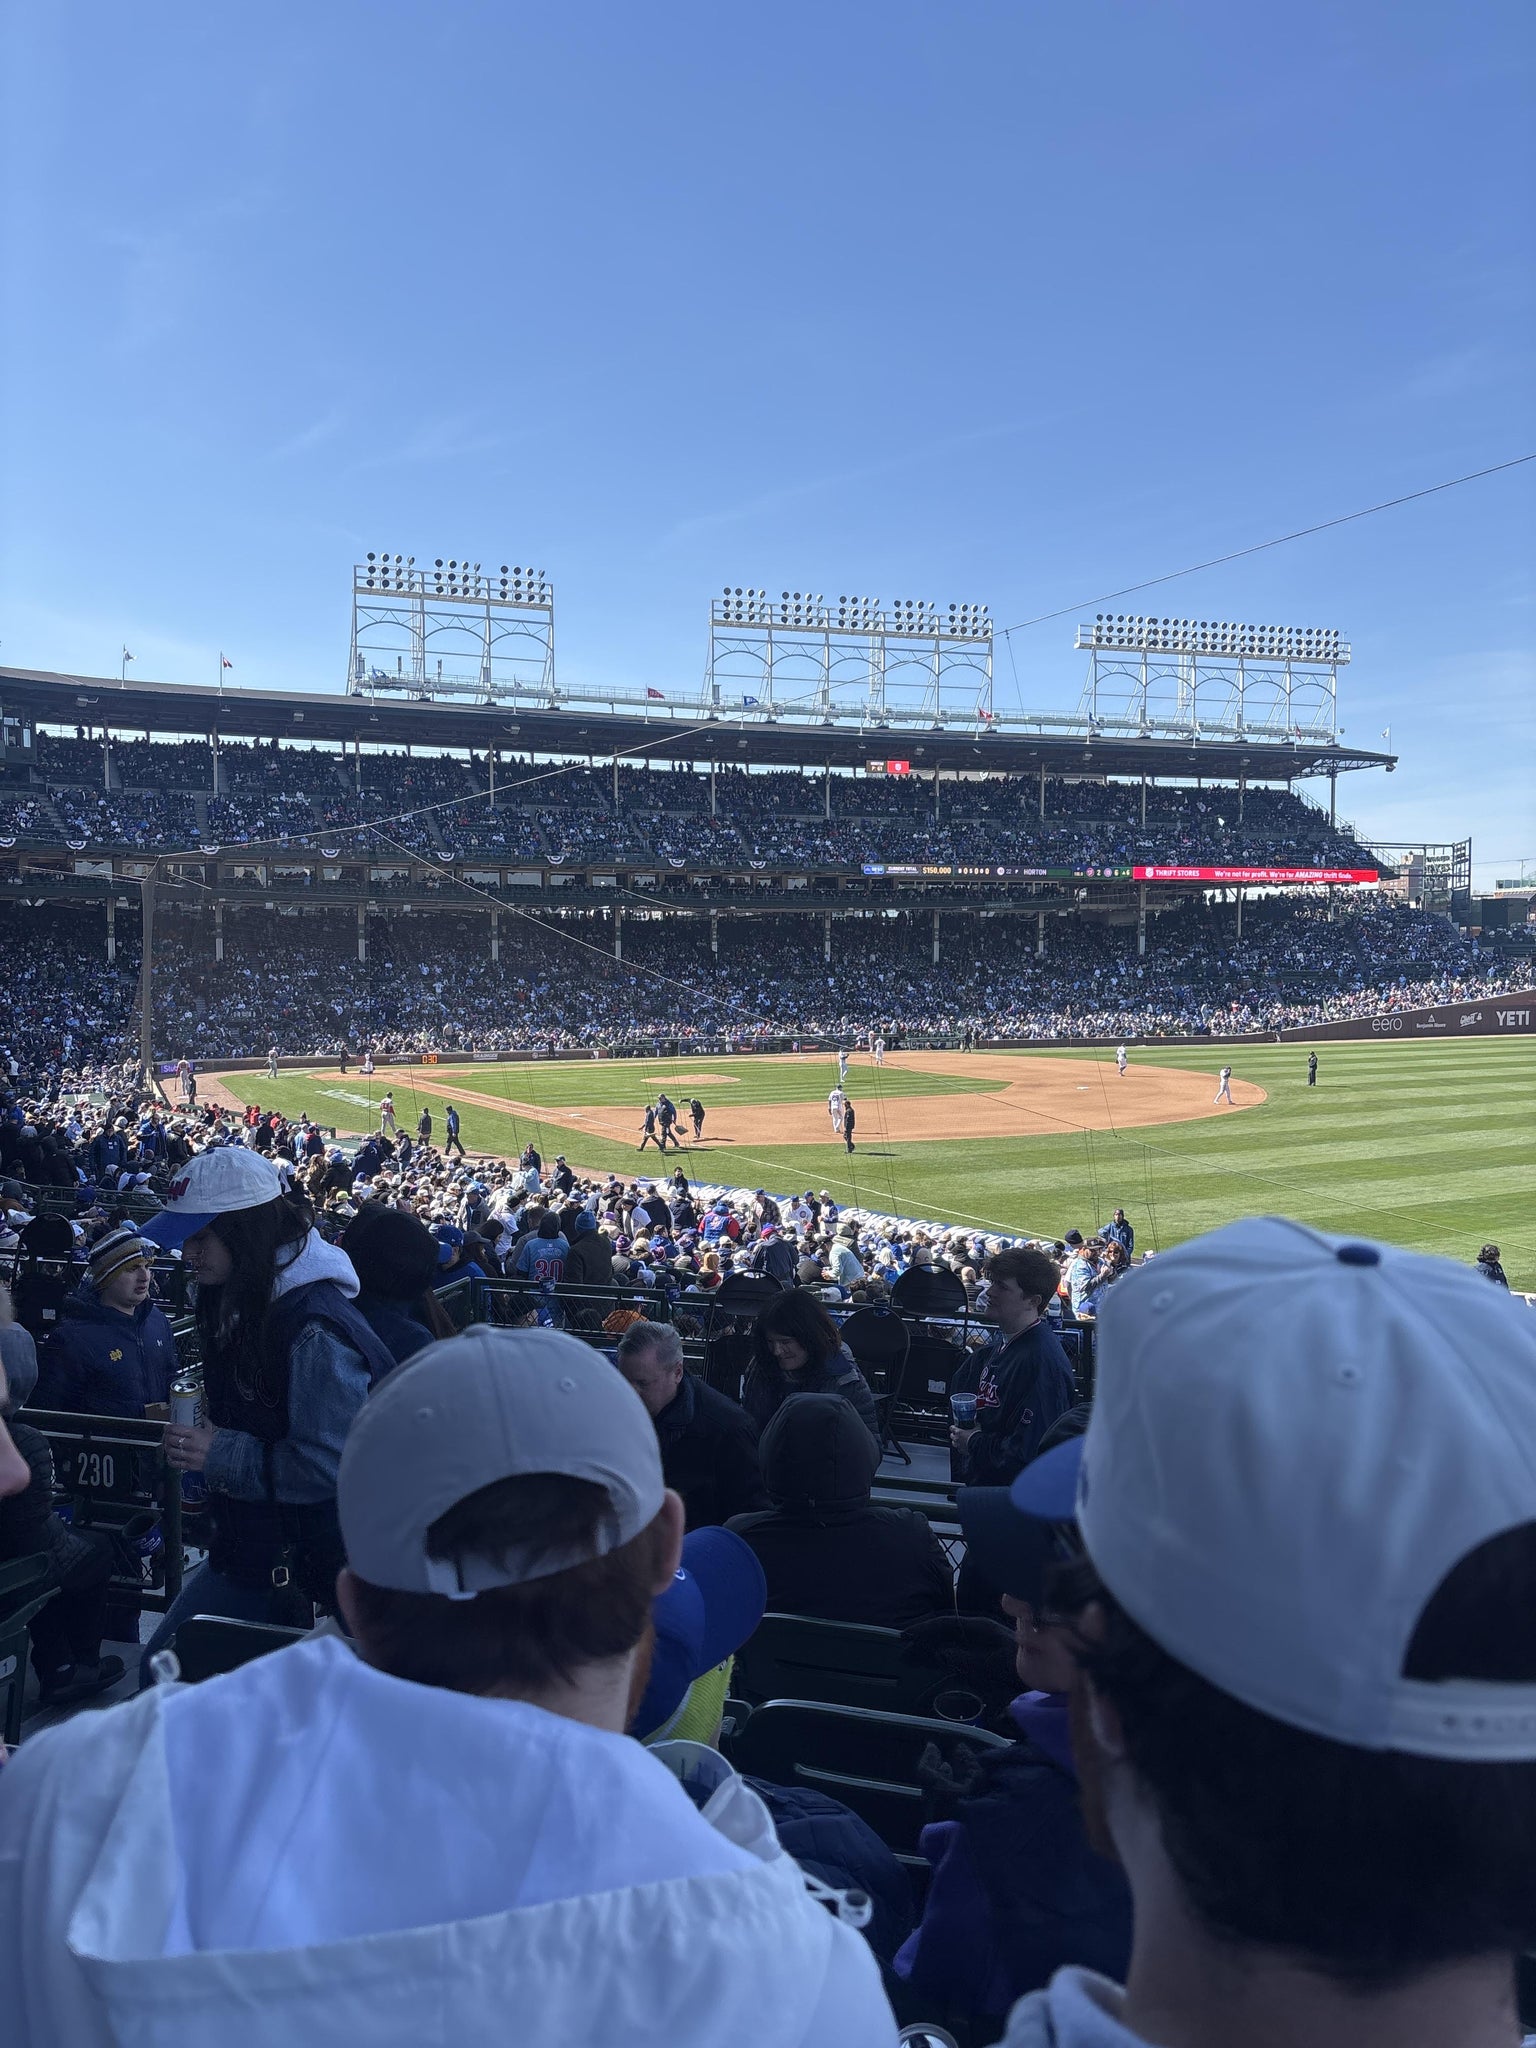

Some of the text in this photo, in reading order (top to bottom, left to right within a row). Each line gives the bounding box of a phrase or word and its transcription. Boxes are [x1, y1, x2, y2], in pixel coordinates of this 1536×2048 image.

[922, 867, 951, 875] $150,000
[1024, 868, 1047, 876] HORTON
[1156, 869, 1200, 877] THRIFT STORES
[1294, 871, 1323, 879] AMAZING
[1496, 1010, 1531, 1026] YETI
[1372, 1017, 1403, 1032] eero
[534, 1258, 563, 1282] 30
[77, 1452, 114, 1488] 230
